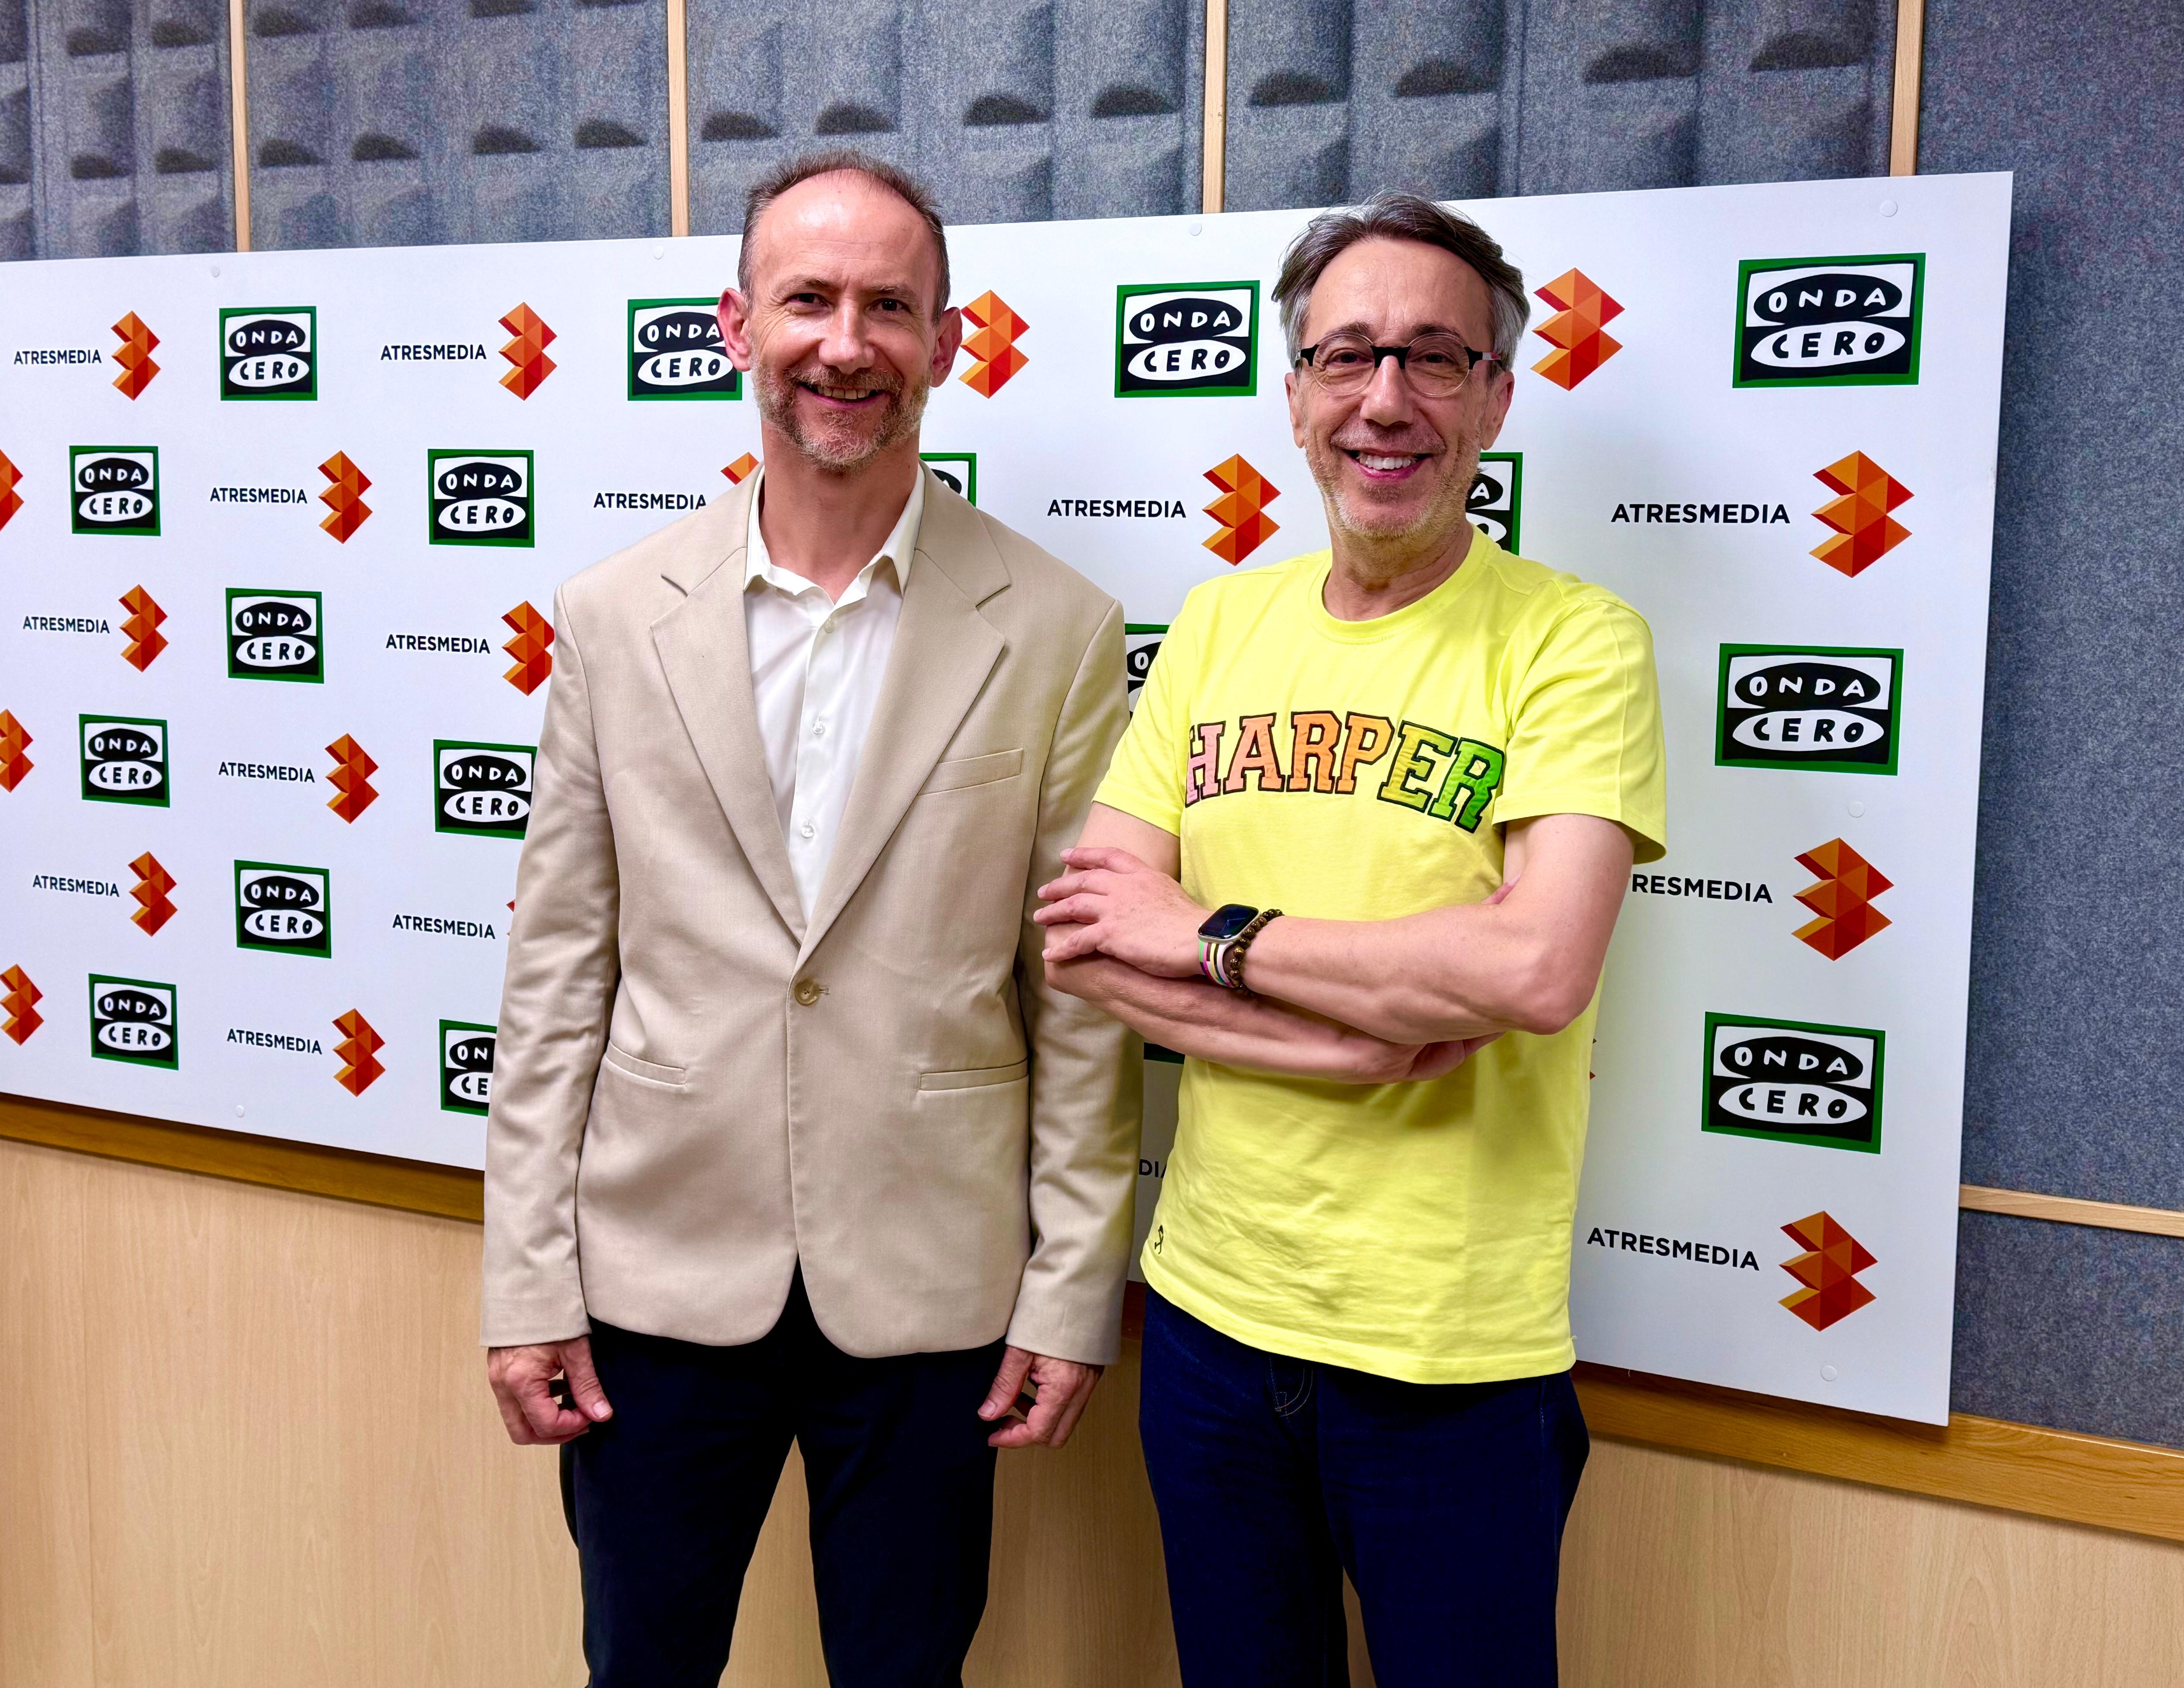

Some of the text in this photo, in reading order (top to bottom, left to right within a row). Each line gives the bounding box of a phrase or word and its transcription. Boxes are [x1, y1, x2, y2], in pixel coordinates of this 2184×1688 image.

[1769, 288, 1886, 312] ONDA
[1141, 311, 1230, 332] ONDA
[236, 331, 298, 347] ONDA
[647, 323, 720, 342] ONDA
[381, 344, 486, 360] ATRESMEDIA
[1772, 331, 1884, 358] CERO
[14, 349, 101, 364] ATRESMEDIA
[1144, 349, 1229, 372] CERO
[240, 362, 298, 380] CERO
[651, 358, 720, 378] CERO
[85, 468, 142, 483] ONDA
[446, 474, 513, 489] ONDA
[210, 488, 307, 503] ATRESMEDIA
[594, 493, 706, 510] ATRESMEDIA
[90, 498, 142, 515] CERO
[450, 505, 514, 524] CERO
[1048, 500, 1186, 518] ATRESMEDIA
[1611, 504, 1790, 523] ATRESMEDIA
[23, 616, 110, 633] ATRESMEDIA
[243, 612, 303, 626] ONDA
[247, 642, 305, 660] CERO
[386, 634, 490, 654] ATRESMEDIA
[1750, 677, 1865, 697] ONDA
[1753, 717, 1864, 742] CERO
[95, 737, 151, 753] ONDA
[99, 767, 152, 784] CERO
[219, 762, 315, 782] ATRESMEDIA
[452, 765, 517, 782] ONDA
[1185, 711, 1506, 834] HARPER
[456, 796, 518, 816] CERO
[33, 875, 119, 897] ATRESMEDIA
[251, 885, 311, 902] ONDA
[1632, 874, 1772, 903] RESMEDIA
[256, 914, 312, 934] CERO
[393, 914, 495, 939] ATRESMEDIA
[104, 997, 159, 1016] ONDA
[109, 1026, 161, 1046] CERO
[227, 1029, 322, 1055] ATRESMEDIA
[1735, 1047, 1847, 1074] ONDA
[1739, 1088, 1847, 1118] CERO
[1587, 1228, 1759, 1270] ATRESMEDIA
